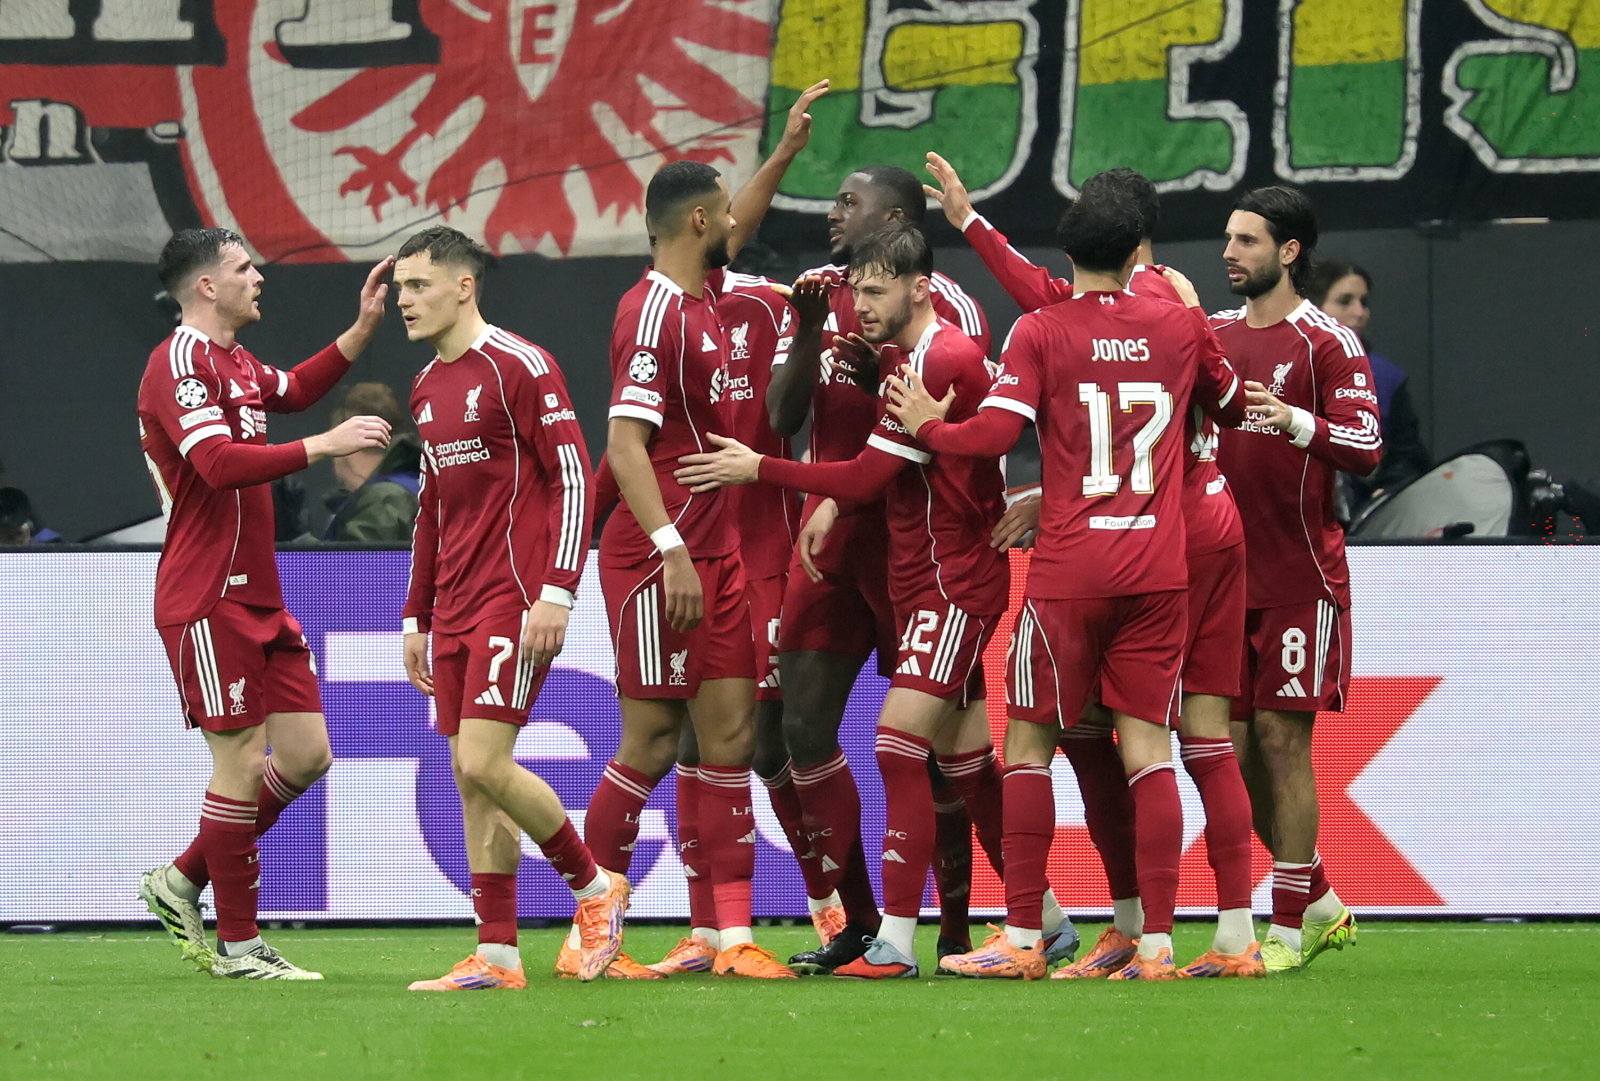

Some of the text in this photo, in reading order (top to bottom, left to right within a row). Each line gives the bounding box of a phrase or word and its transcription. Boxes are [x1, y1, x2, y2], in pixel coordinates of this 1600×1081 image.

[539, 407, 577, 427] xpedia
[435, 436, 483, 456] standard
[1078, 382, 1174, 498] 17
[438, 447, 491, 469] chartered
[488, 635, 515, 684] 7
[1281, 627, 1307, 675] 8
